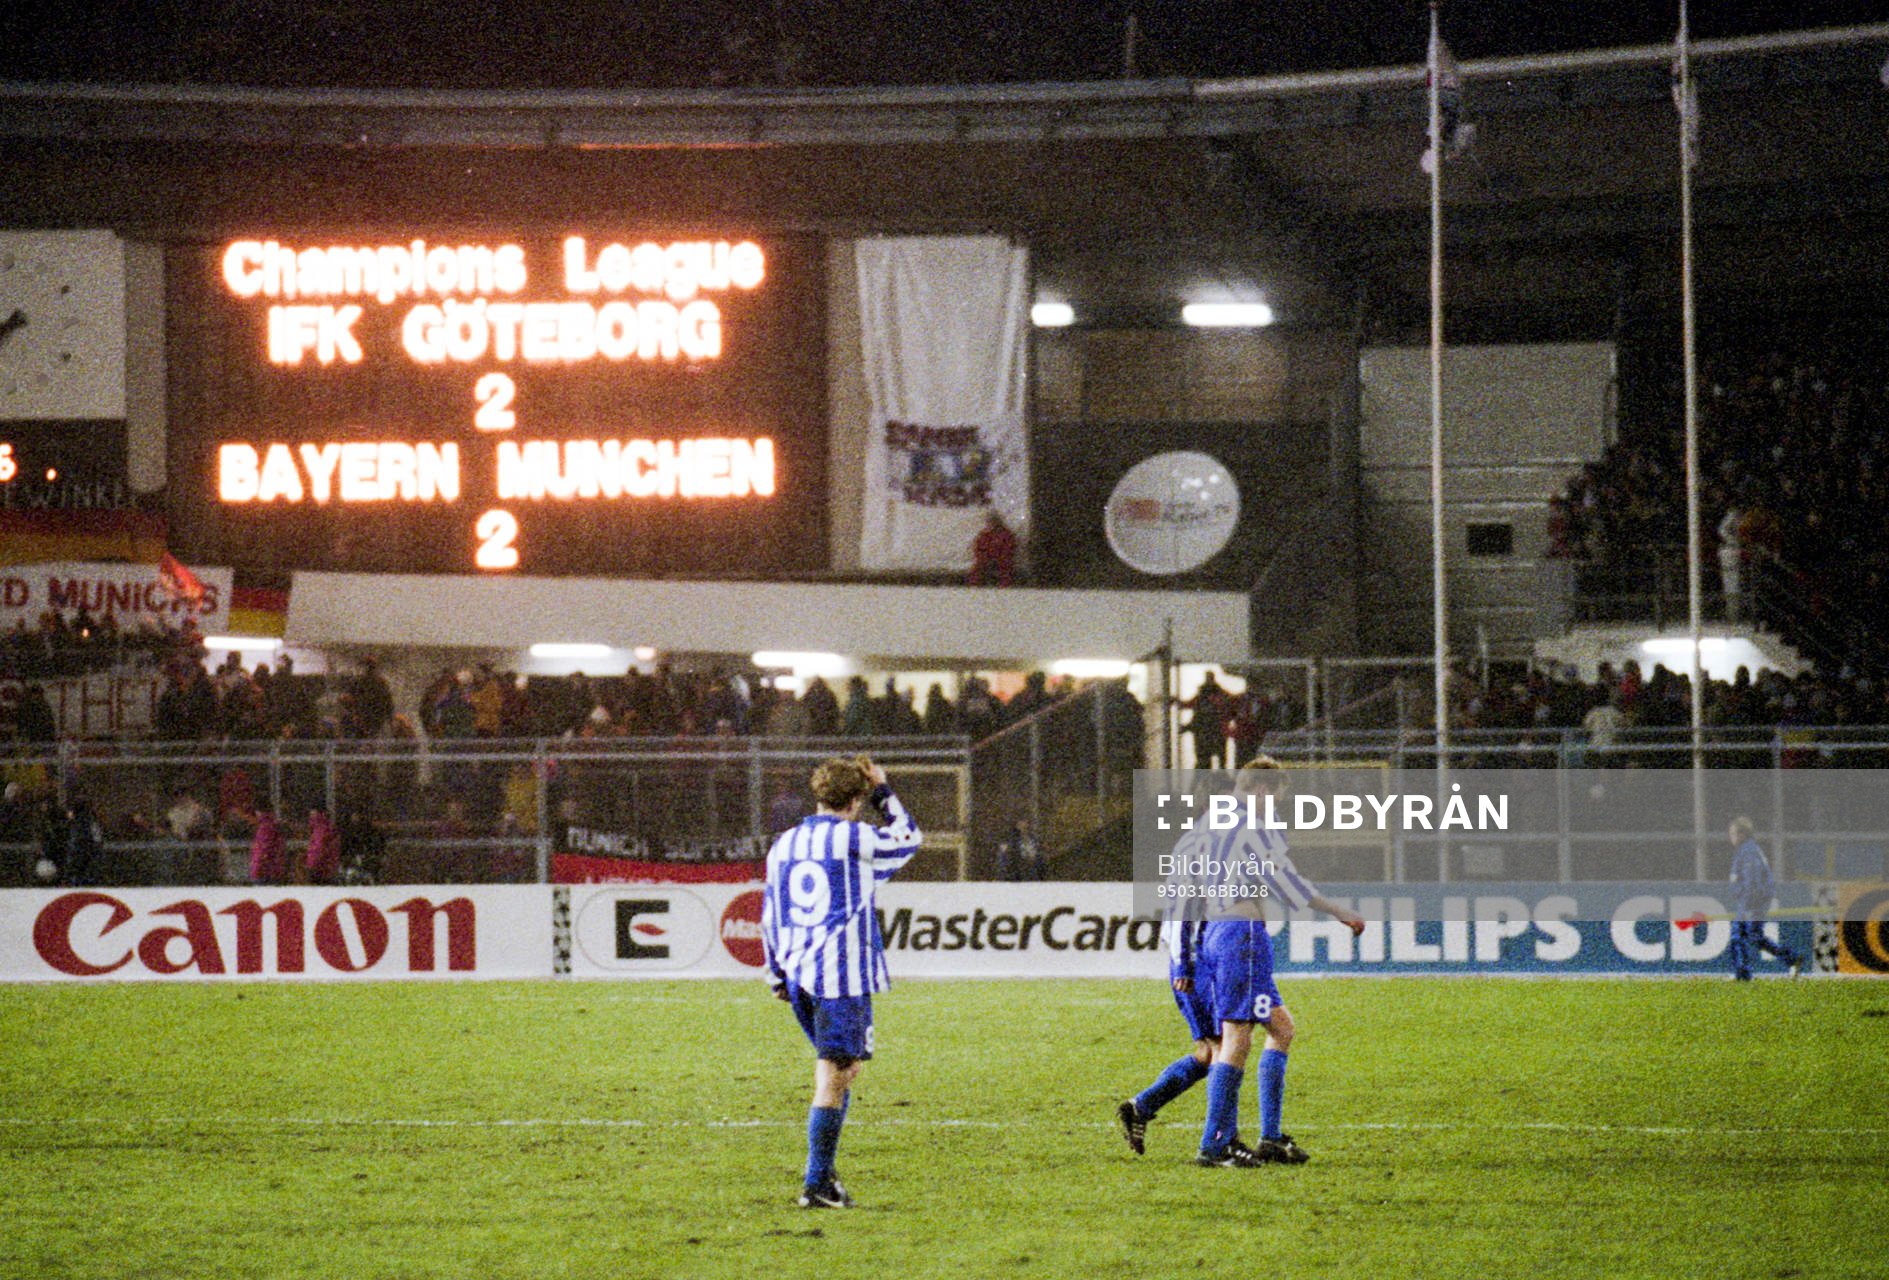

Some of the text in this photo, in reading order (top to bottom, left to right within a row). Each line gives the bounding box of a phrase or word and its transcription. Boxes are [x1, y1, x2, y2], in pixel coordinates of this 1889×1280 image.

[222, 236, 767, 304] Champions League
[267, 297, 722, 365] IFK GÖTEBORG
[473, 372, 517, 431] 2
[218, 437, 776, 502] BAYERN MUNCHEN
[474, 508, 519, 569] 2
[2, 577, 30, 607] D
[788, 860, 832, 928] 9
[33, 892, 477, 977] Canon
[876, 906, 1162, 951] MasterCard
[1252, 993, 1273, 1018] 8
